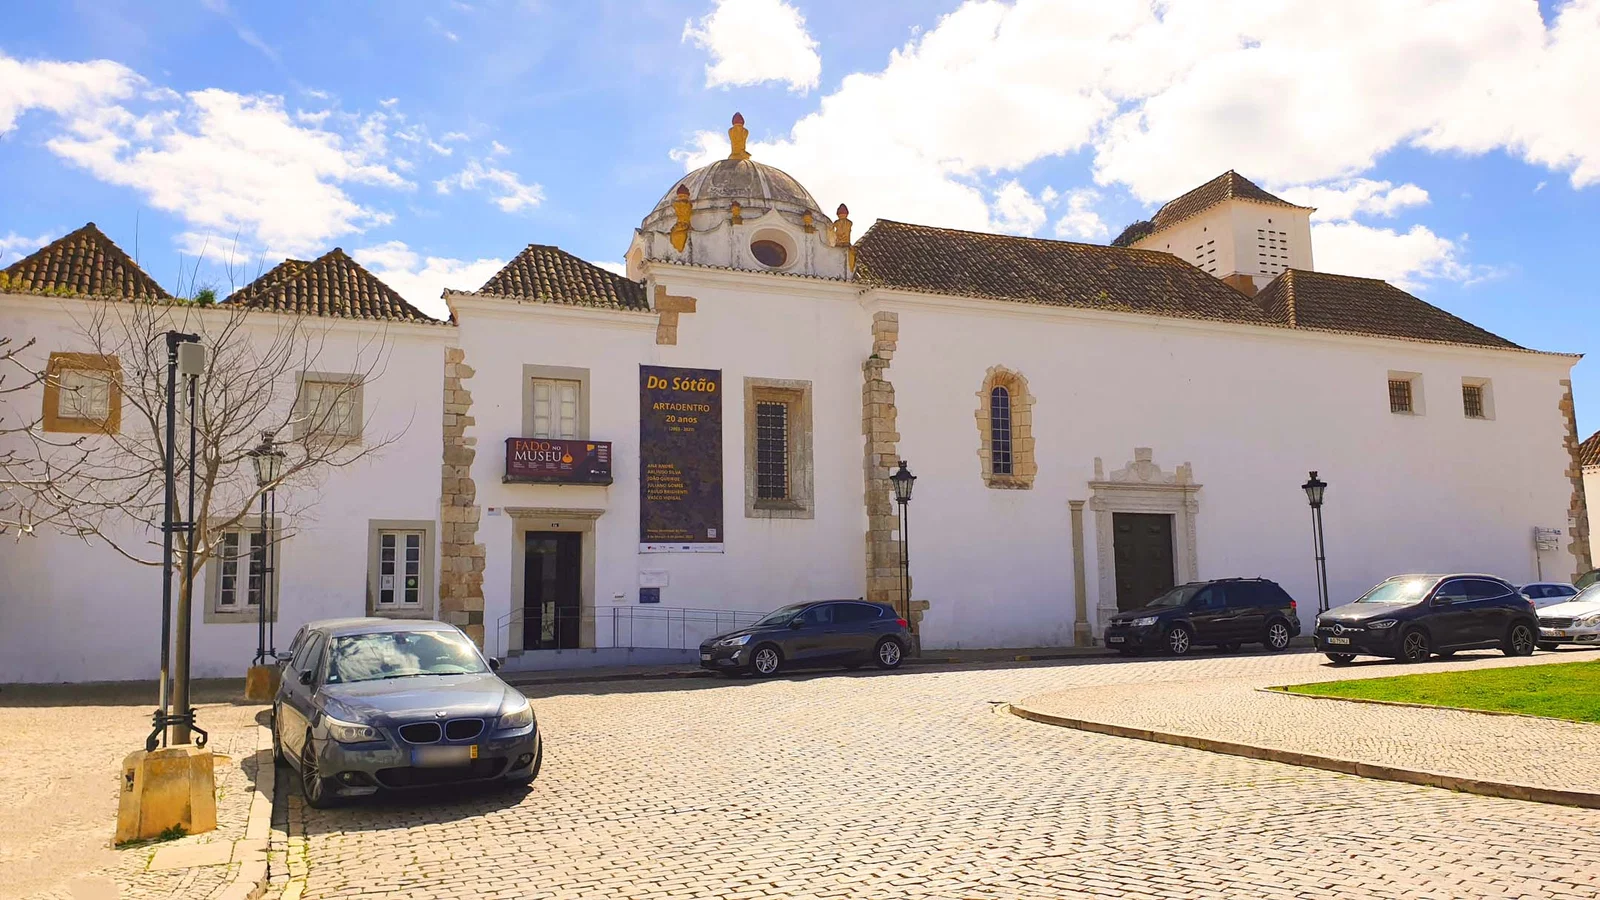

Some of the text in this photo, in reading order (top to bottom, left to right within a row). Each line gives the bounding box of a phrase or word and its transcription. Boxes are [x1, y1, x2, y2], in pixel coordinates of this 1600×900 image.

[647, 375, 715, 392] Do Sótão
[653, 402, 710, 412] ARTADENTRO
[666, 415, 698, 424] 20 anos
[515, 440, 550, 451] FADO
[515, 451, 561, 462] MUSEU
